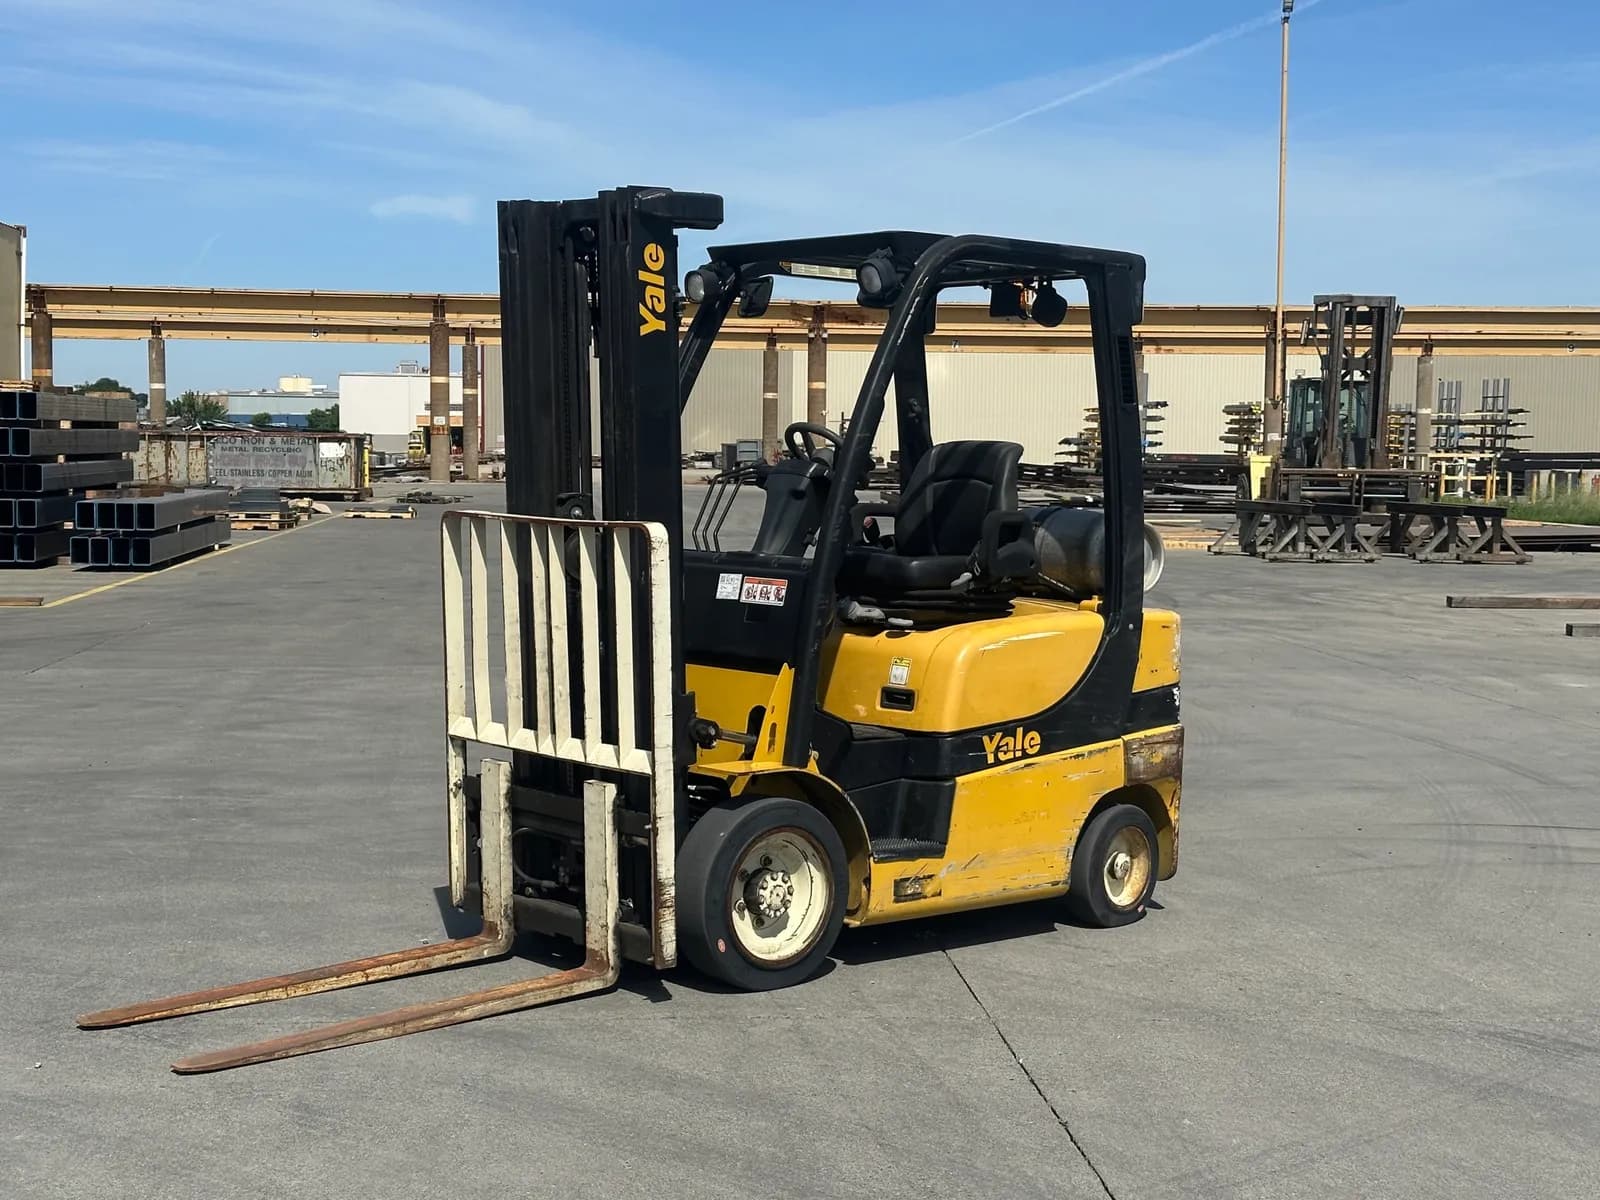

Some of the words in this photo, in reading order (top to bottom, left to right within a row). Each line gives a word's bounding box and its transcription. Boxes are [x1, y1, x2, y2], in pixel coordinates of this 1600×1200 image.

[639, 243, 666, 336] Yale
[240, 437, 265, 445] IRON
[281, 438, 313, 446] METAL
[982, 726, 1041, 764] Yale
